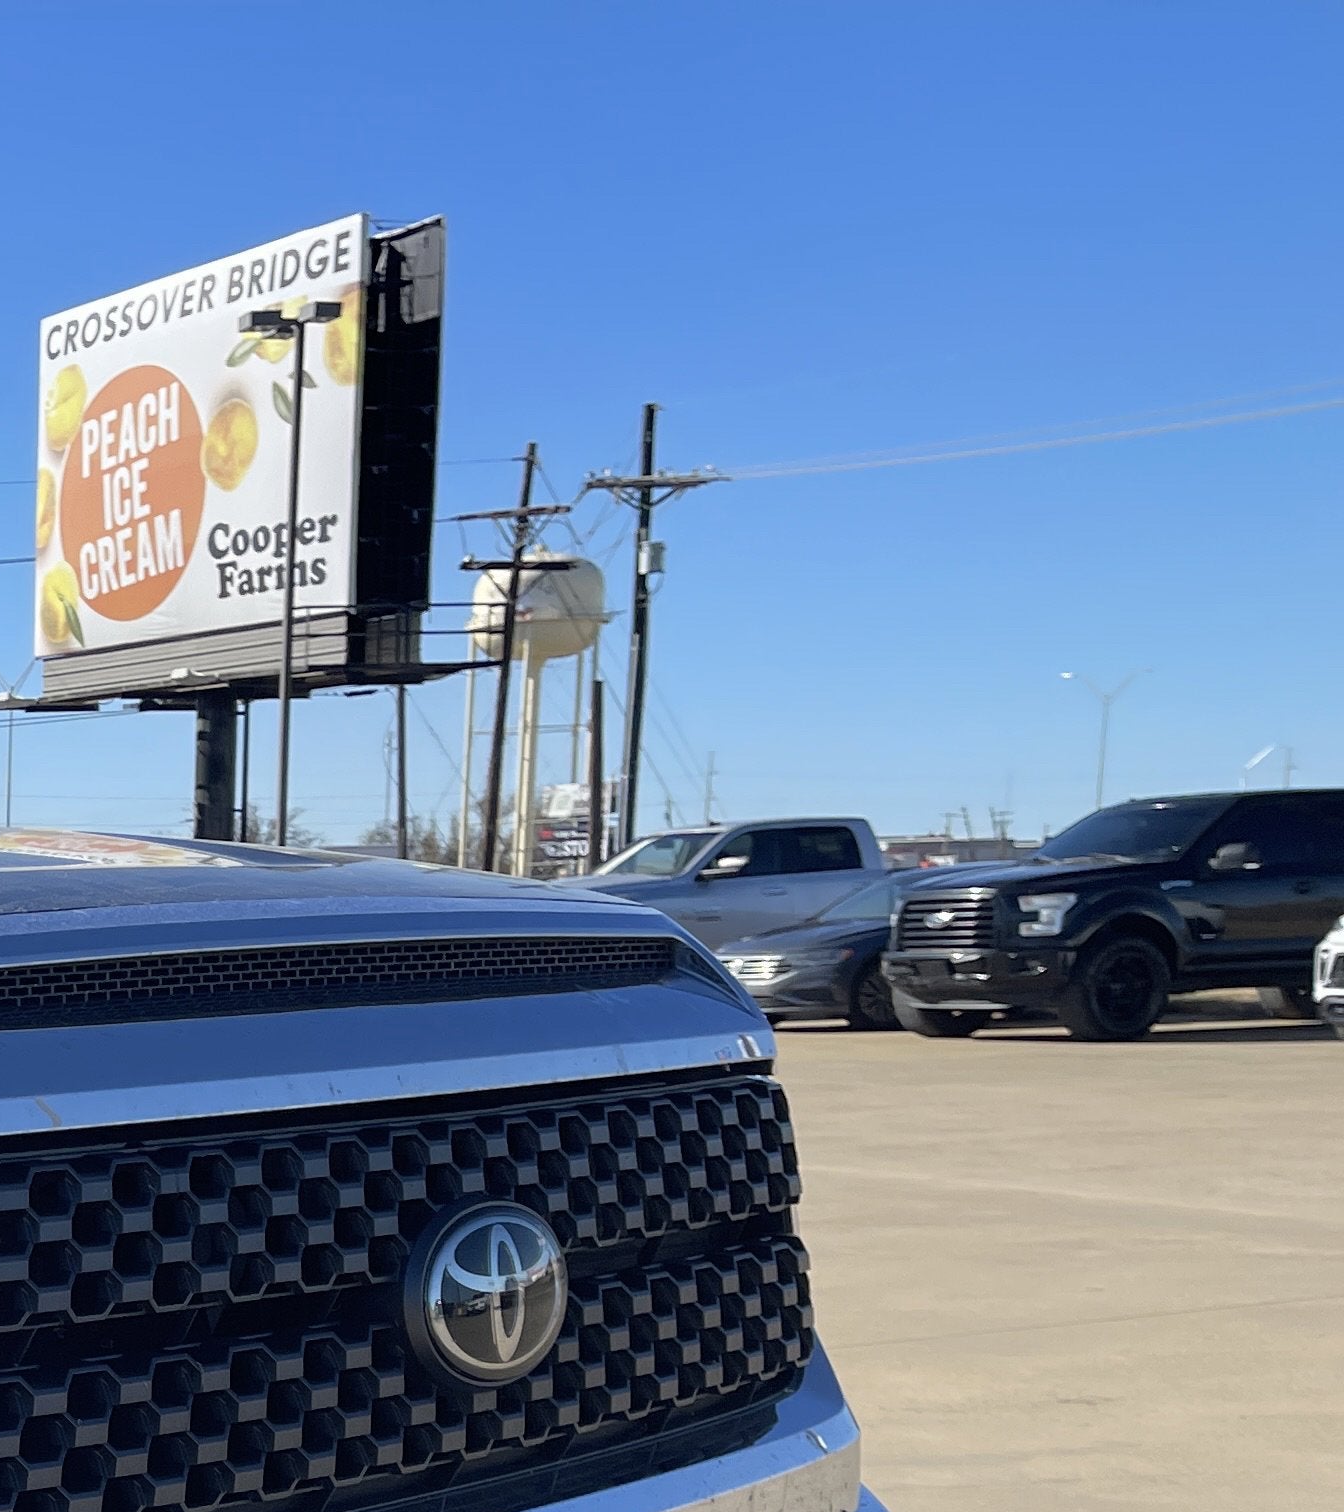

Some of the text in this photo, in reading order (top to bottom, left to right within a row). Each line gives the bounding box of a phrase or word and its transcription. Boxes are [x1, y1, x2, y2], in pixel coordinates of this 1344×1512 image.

[46, 230, 353, 360] CROSSOVER BRIDGE
[80, 381, 180, 479] PEACH
[102, 459, 150, 530] ICE
[79, 509, 185, 600] CREAM
[208, 514, 338, 560] Cooper
[216, 557, 327, 599] Farms
